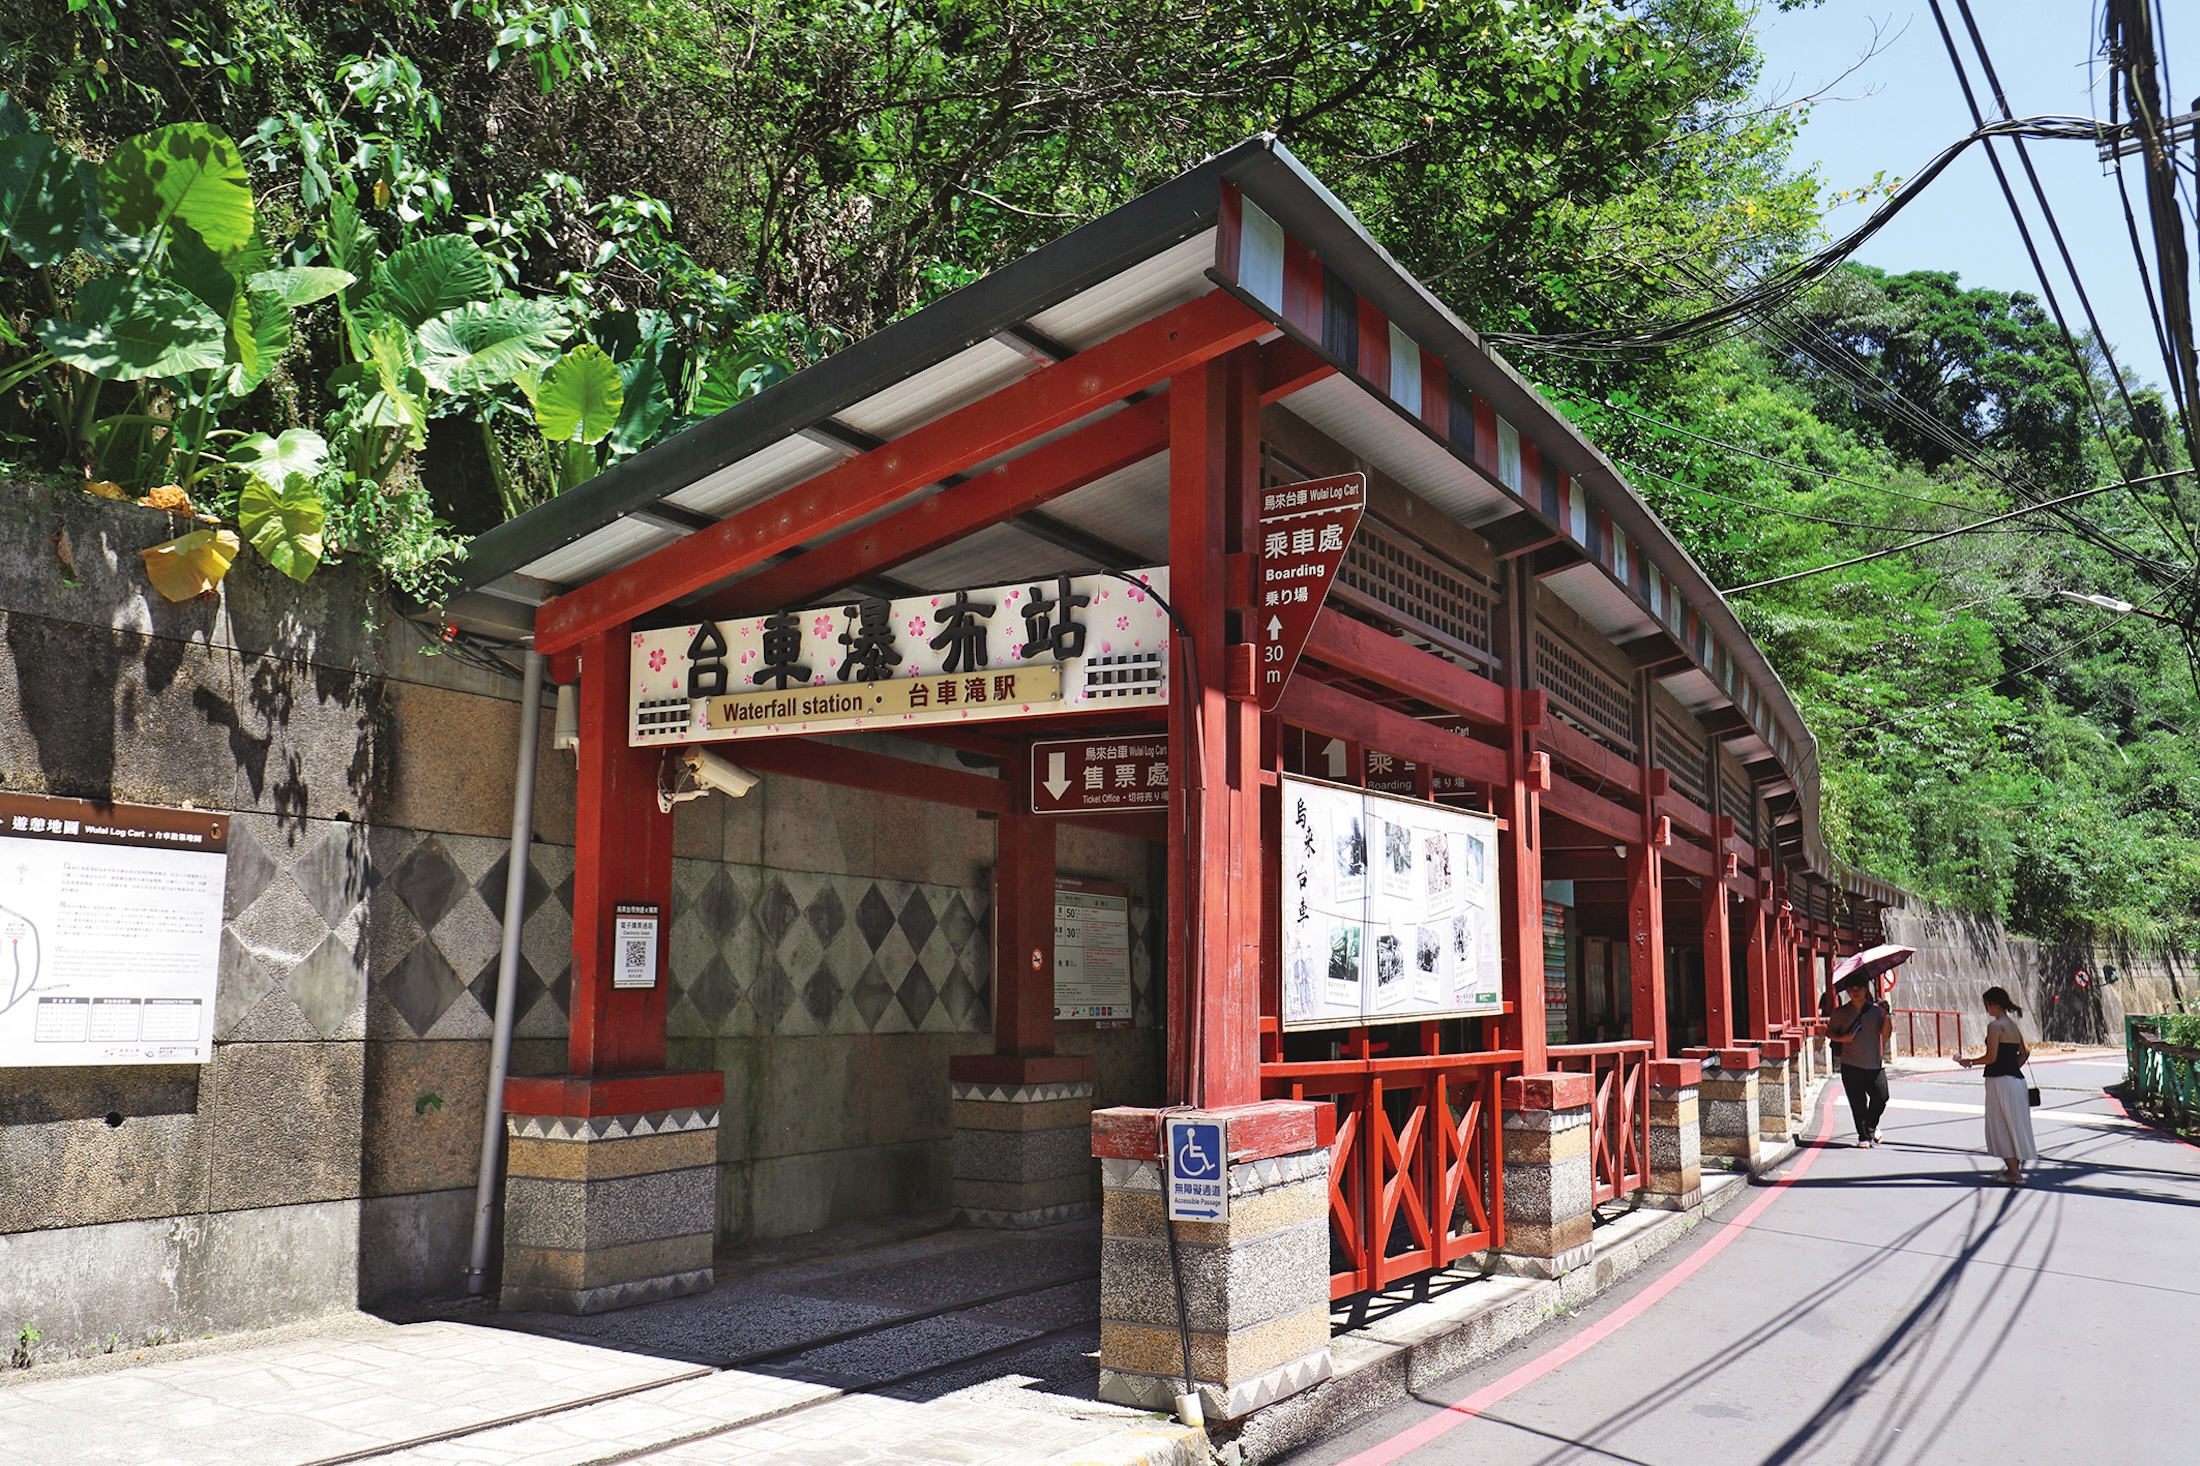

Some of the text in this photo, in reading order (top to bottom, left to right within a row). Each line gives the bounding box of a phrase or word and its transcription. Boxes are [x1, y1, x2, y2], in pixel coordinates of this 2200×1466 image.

[1264, 483, 1359, 511] 烏來台車 Wulai Log Cart
[1264, 523, 1344, 559] 乘車處
[1265, 563, 1325, 582] Boarding
[1265, 586, 1309, 606] 乗り場
[687, 574, 1091, 700] 台車瀑布站
[1264, 645, 1284, 662] 30
[1266, 669, 1281, 683] m
[723, 674, 1016, 722] Waterfall station 台車滝駅
[1085, 744, 1167, 761] 烏來台車 Wulai Log Cart
[1083, 762, 1169, 790] 售票處
[1367, 779, 1412, 792] Boarding
[1083, 794, 1101, 804] Ticket
[1102, 793, 1121, 804] Office
[85, 824, 109, 835] Wulai
[110, 827, 127, 838] Log
[127, 828, 146, 838] Cart
[1066, 908, 1075, 918] 50
[1066, 928, 1076, 938] 30
[1174, 1197, 1221, 1208] Accessible Passage
